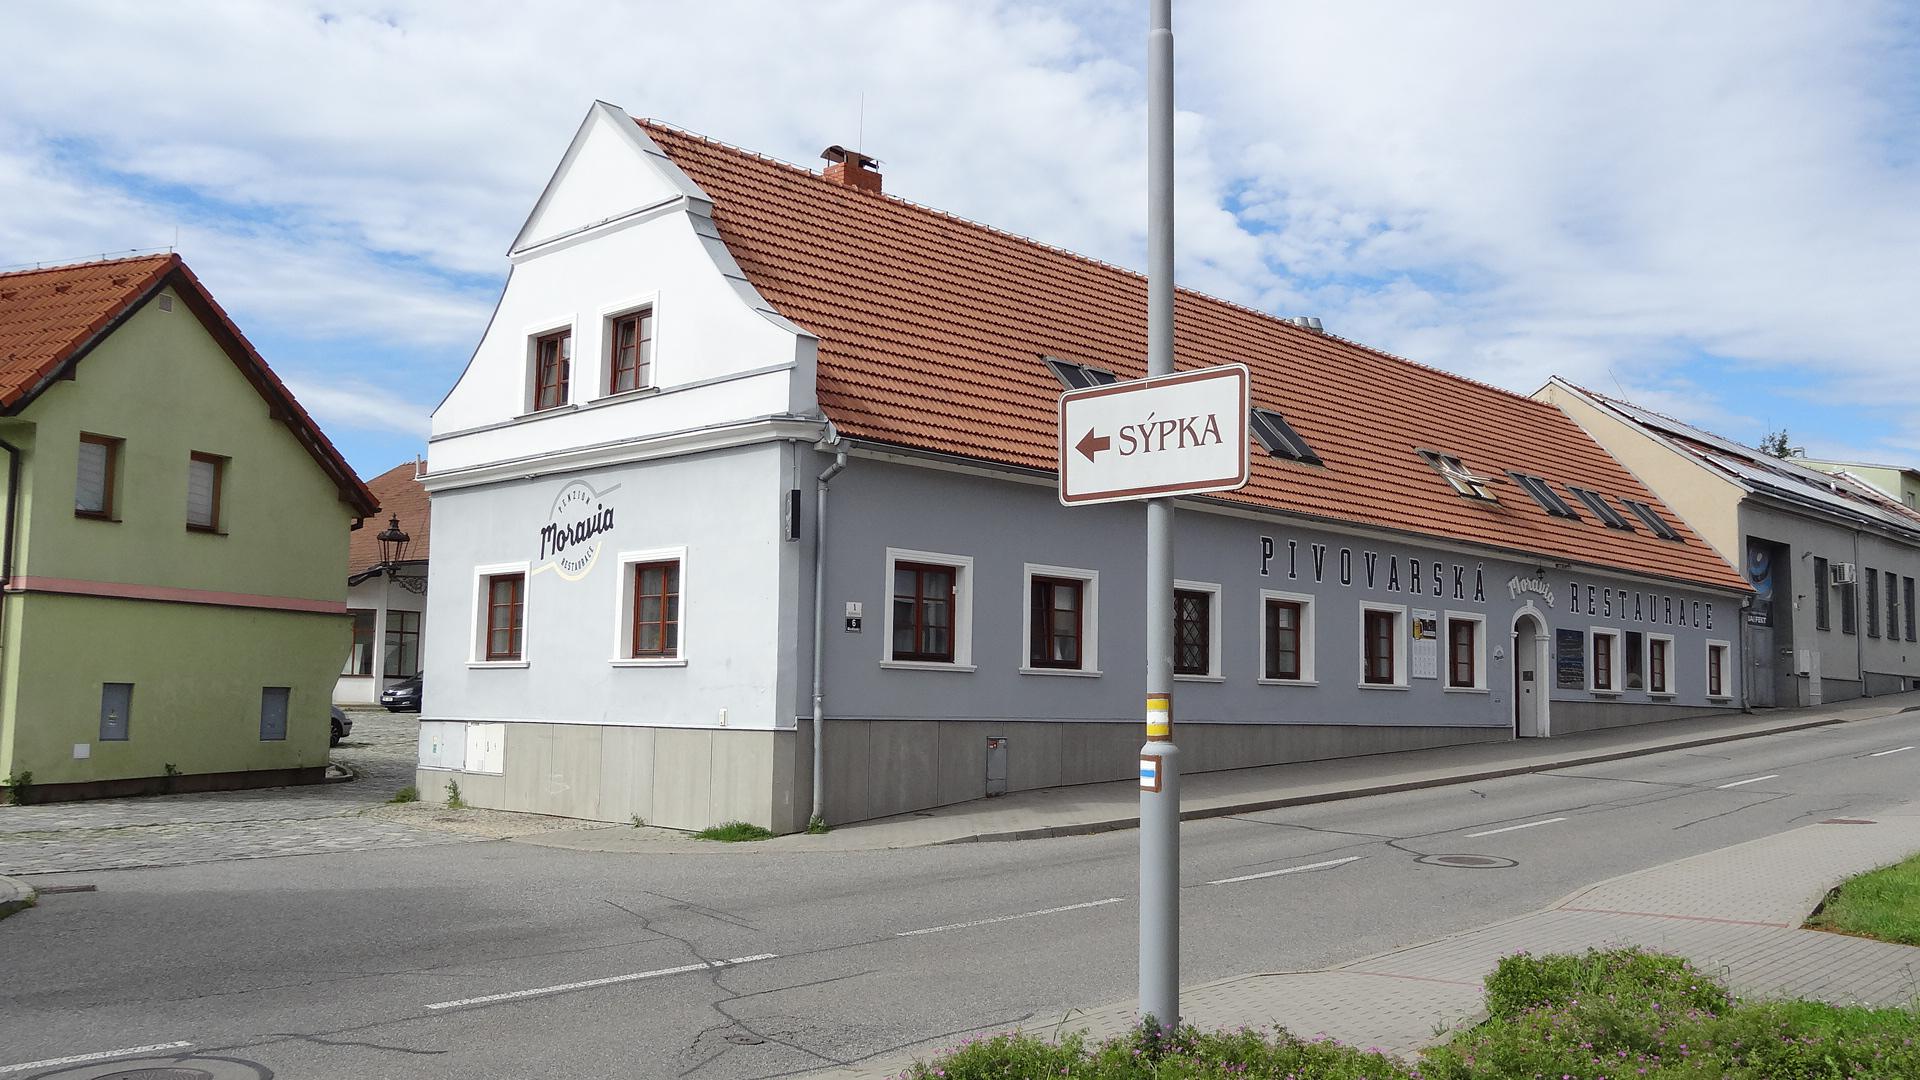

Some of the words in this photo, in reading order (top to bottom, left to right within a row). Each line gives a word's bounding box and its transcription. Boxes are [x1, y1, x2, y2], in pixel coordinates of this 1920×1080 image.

[1118, 411, 1223, 456] SÝPKA
[557, 490, 592, 514] PENZION
[540, 503, 615, 561] Moravia
[560, 545, 595, 572] RESTAURACE
[1259, 535, 1486, 603] PIVOVARSKÁ
[1570, 581, 1713, 631] RESTAURACE
[1507, 575, 1555, 608] Moravia
